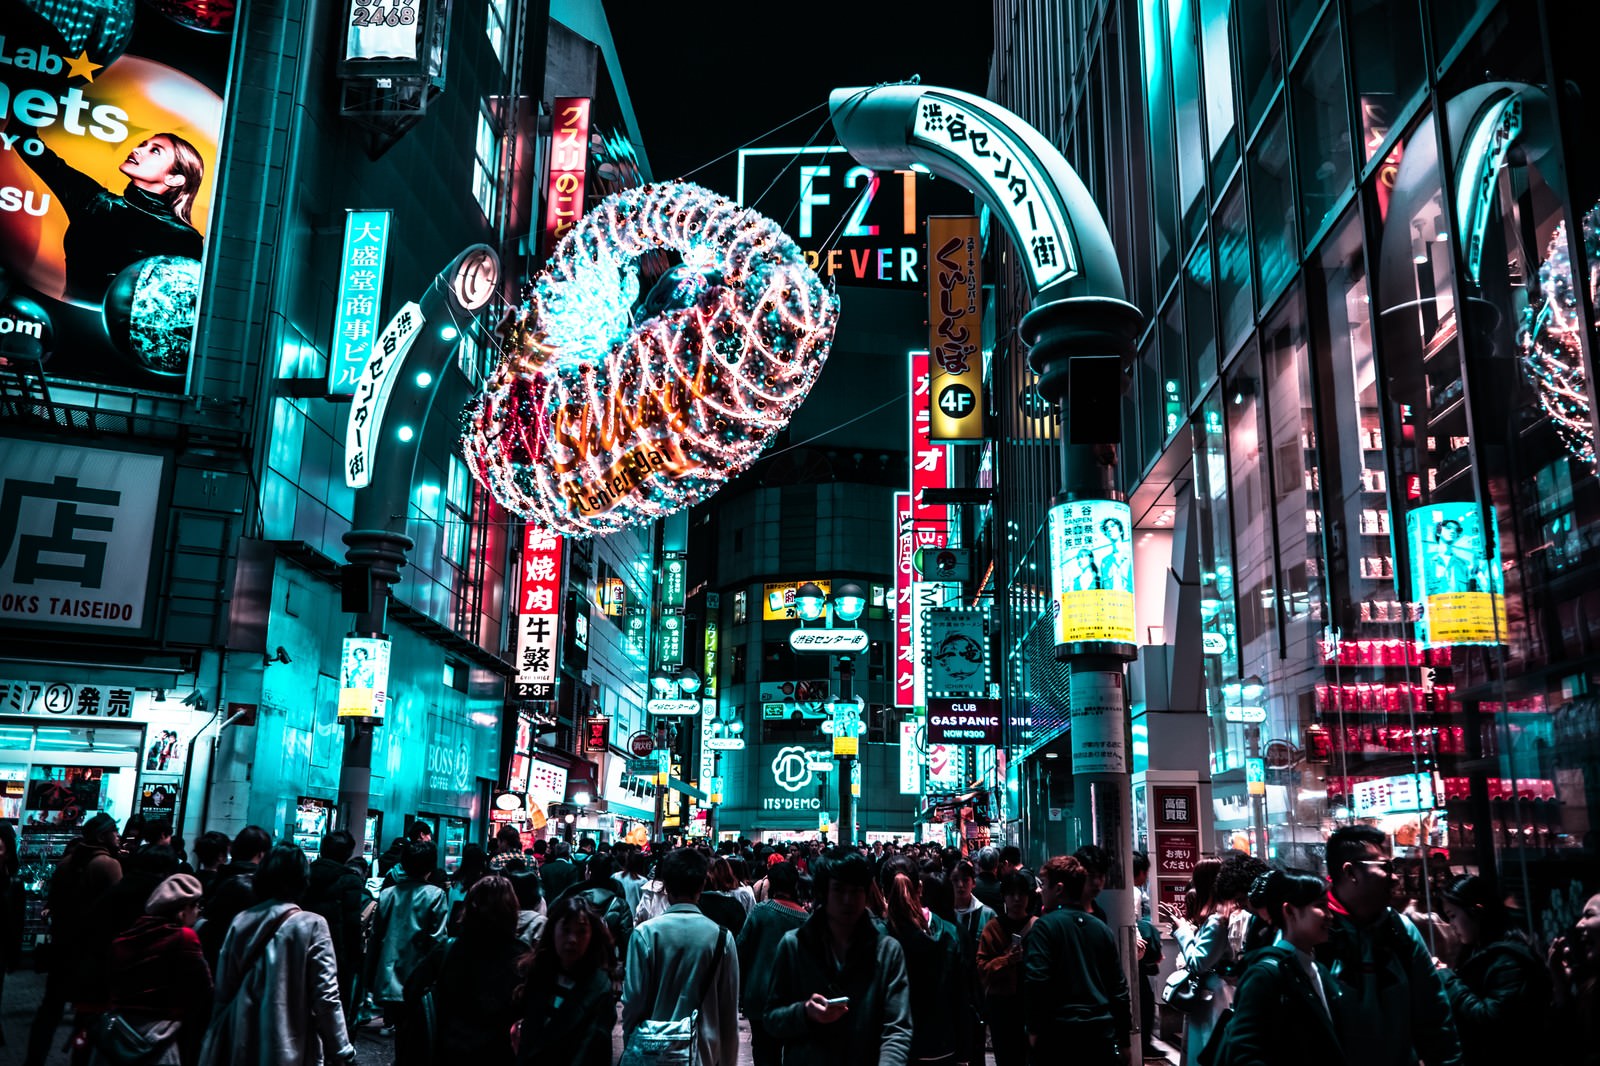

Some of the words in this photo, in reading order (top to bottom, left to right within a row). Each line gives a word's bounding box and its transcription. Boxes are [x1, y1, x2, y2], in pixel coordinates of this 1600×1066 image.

[352, 6, 415, 27] 2468
[0, 35, 62, 75] Lab
[0, 133, 44, 156] YO
[552, 106, 586, 239] クスリのこと
[922, 103, 1057, 268] 渋谷センター街
[0, 186, 50, 218] SU
[799, 165, 917, 238] F21
[337, 221, 382, 386] 大盛堂商事ビル
[349, 311, 412, 481] 渋谷センター街
[940, 390, 971, 412] 4F
[0, 475, 121, 589] 店
[0, 593, 39, 613] OKS
[49, 597, 133, 621] TAISEIDO
[522, 617, 551, 673] 牛繁
[794, 634, 864, 645] 渋谷センター街
[951, 703, 977, 712] CLUB
[930, 716, 958, 726] GAS
[958, 716, 999, 726] PANIC
[427, 744, 454, 776] BOSS
[429, 775, 449, 791] COFFEE
[763, 798, 820, 810] ITS'DEMO
[1165, 798, 1187, 809] 高価
[1165, 809, 1188, 821] 買取
[1162, 861, 1194, 870] ください
[1165, 849, 1191, 860] お売り
